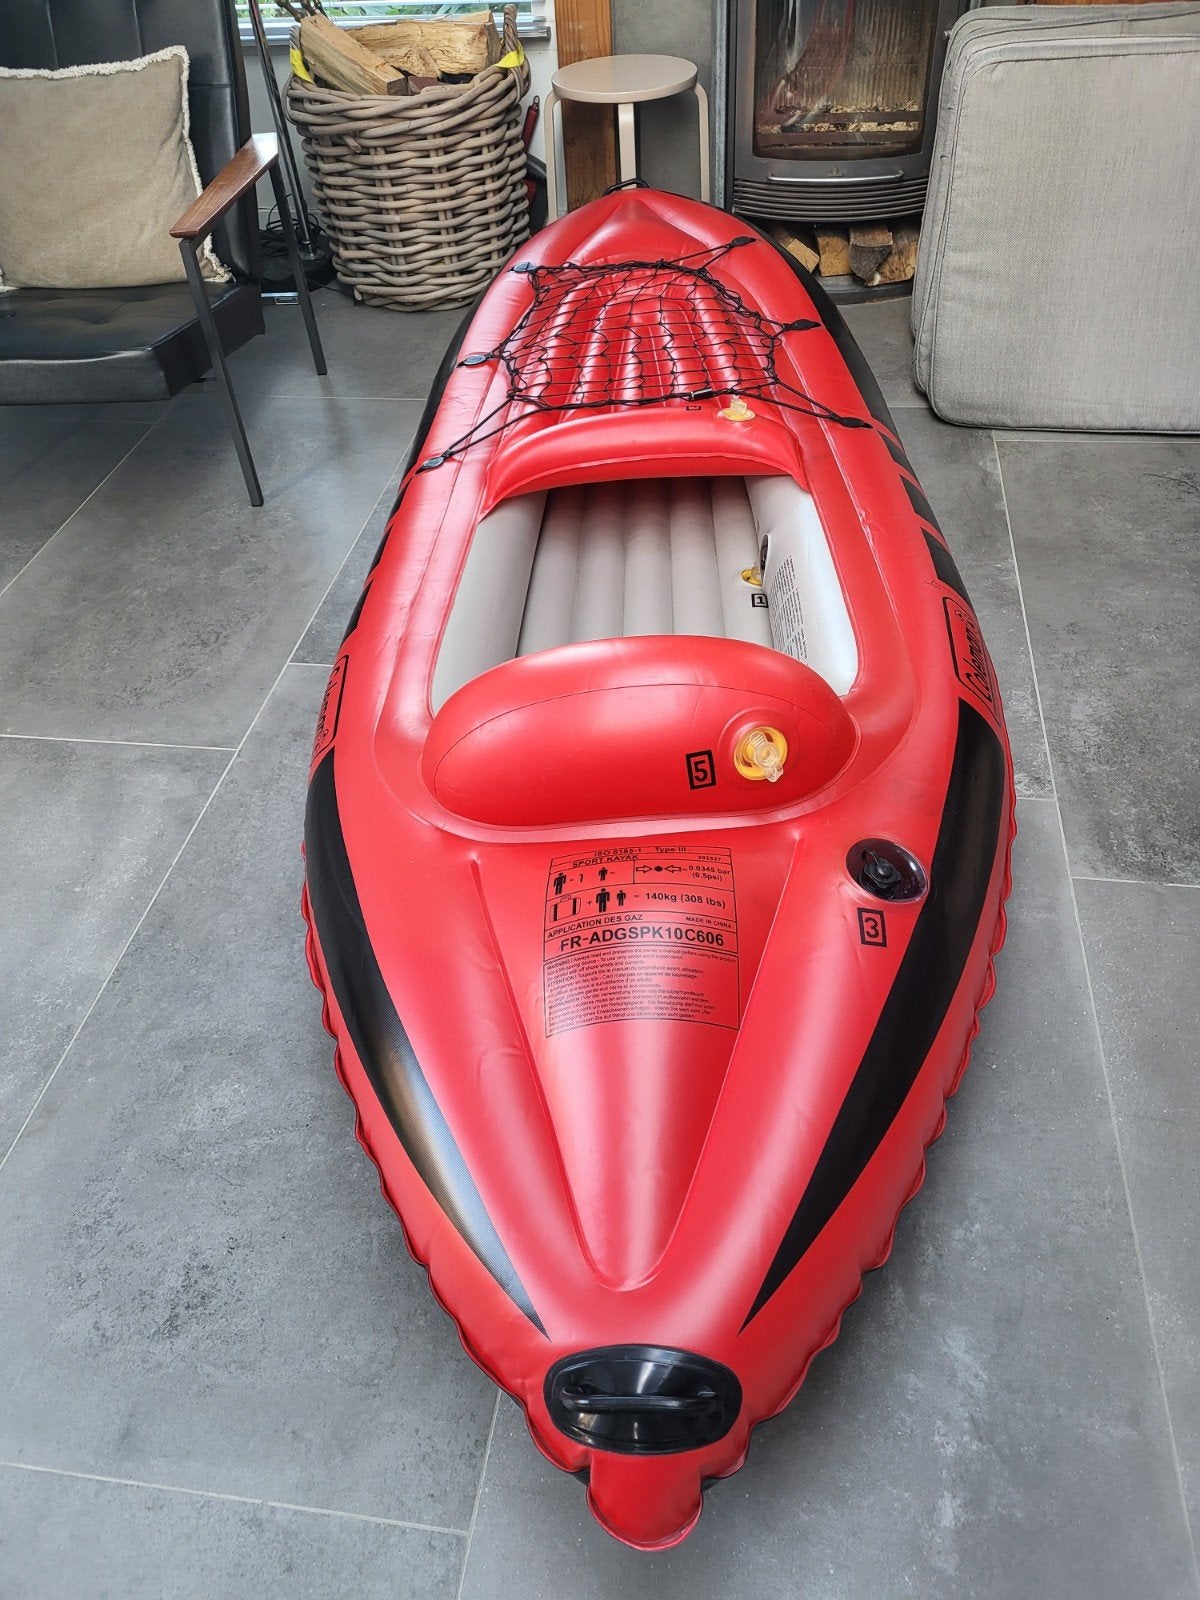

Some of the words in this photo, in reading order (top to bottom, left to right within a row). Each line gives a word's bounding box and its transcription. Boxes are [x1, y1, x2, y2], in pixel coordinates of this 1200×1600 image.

[694, 760, 708, 783] 5
[572, 858, 603, 868] SPORT
[607, 854, 639, 863] KAYAK
[688, 865, 715, 873] 0.0345
[717, 867, 730, 875] bar
[692, 872, 723, 882] (0.5psi)
[646, 892, 677, 902] 140kg
[680, 894, 703, 904] (308
[706, 897, 726, 910] lbs)
[547, 917, 602, 939] APPLICATION
[604, 915, 622, 924] DES
[685, 916, 705, 924] MADE
[713, 920, 732, 929] CHINA
[864, 917, 879, 939] 3
[560, 926, 724, 951] FR-ADGSPK10C606
